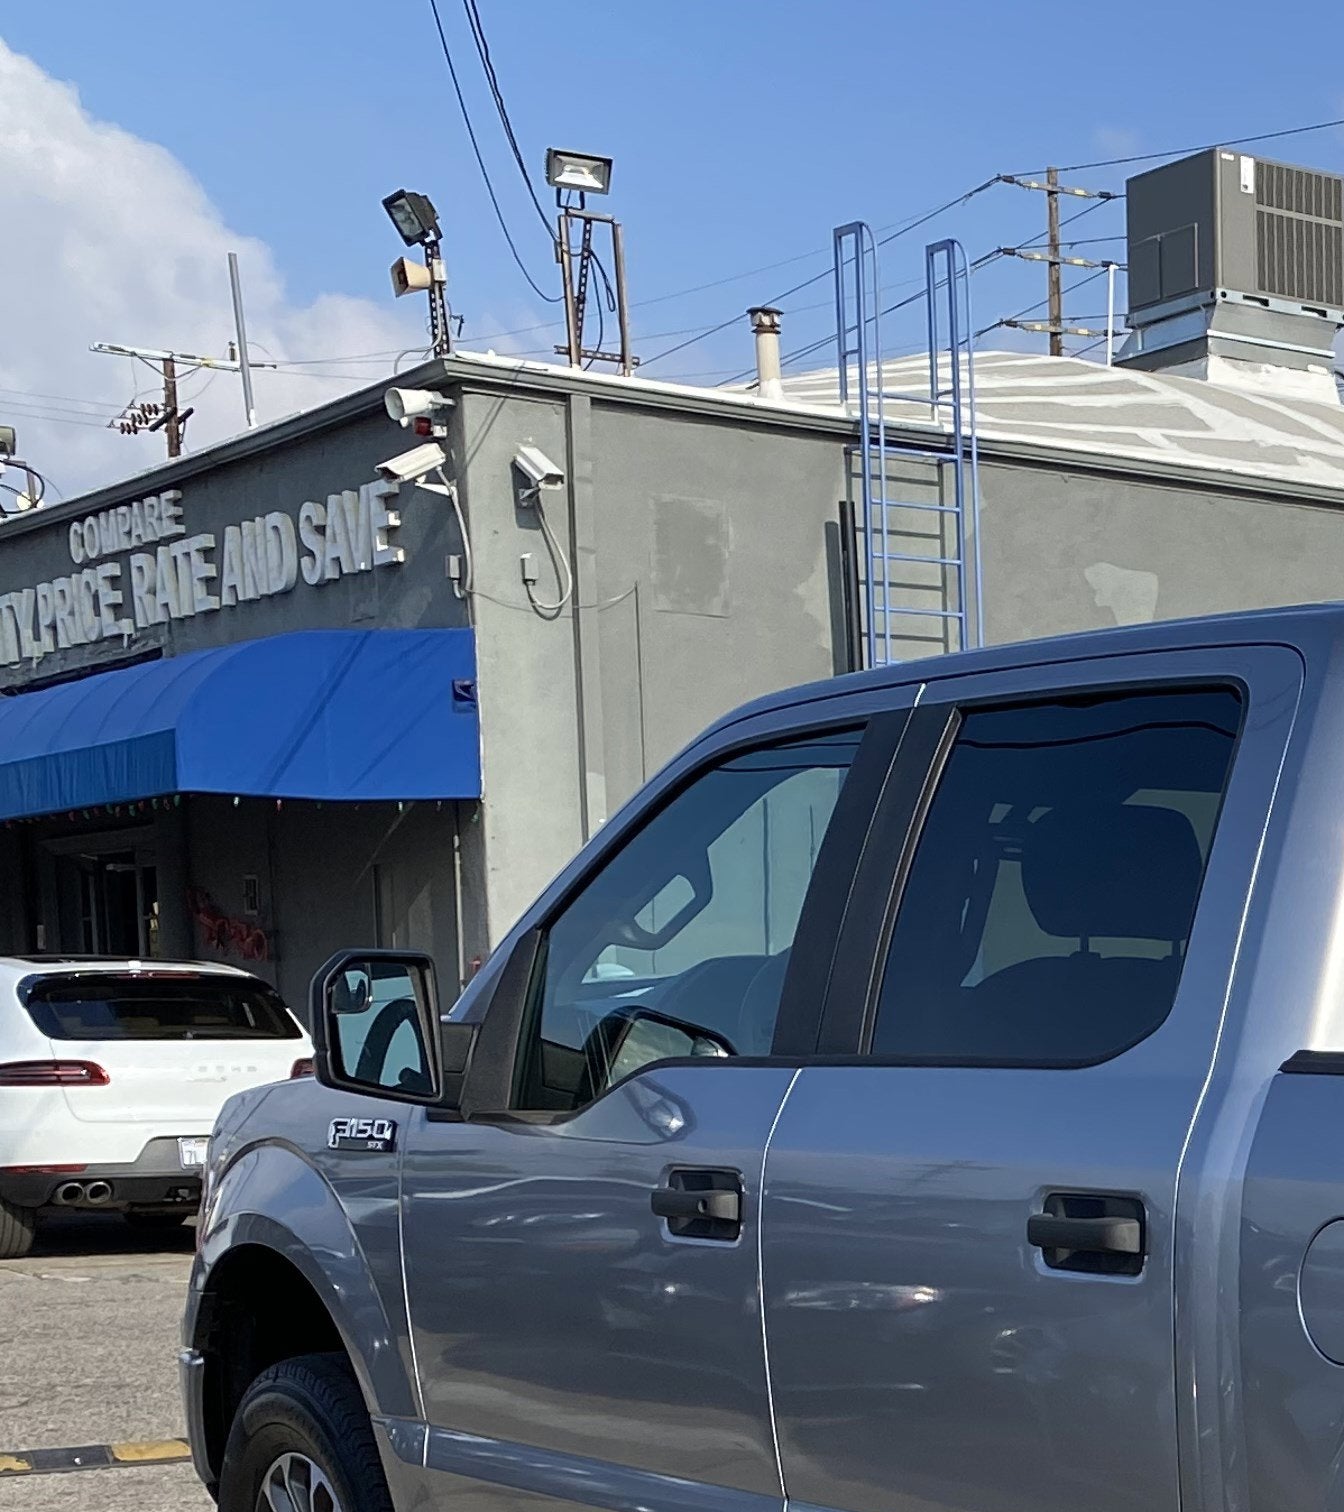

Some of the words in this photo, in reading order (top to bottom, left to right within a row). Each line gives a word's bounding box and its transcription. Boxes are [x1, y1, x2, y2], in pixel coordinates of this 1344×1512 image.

[69, 489, 186, 564] COMPARE
[130, 533, 219, 628] RATE
[221, 511, 298, 606] AND
[299, 478, 404, 586] SAVE
